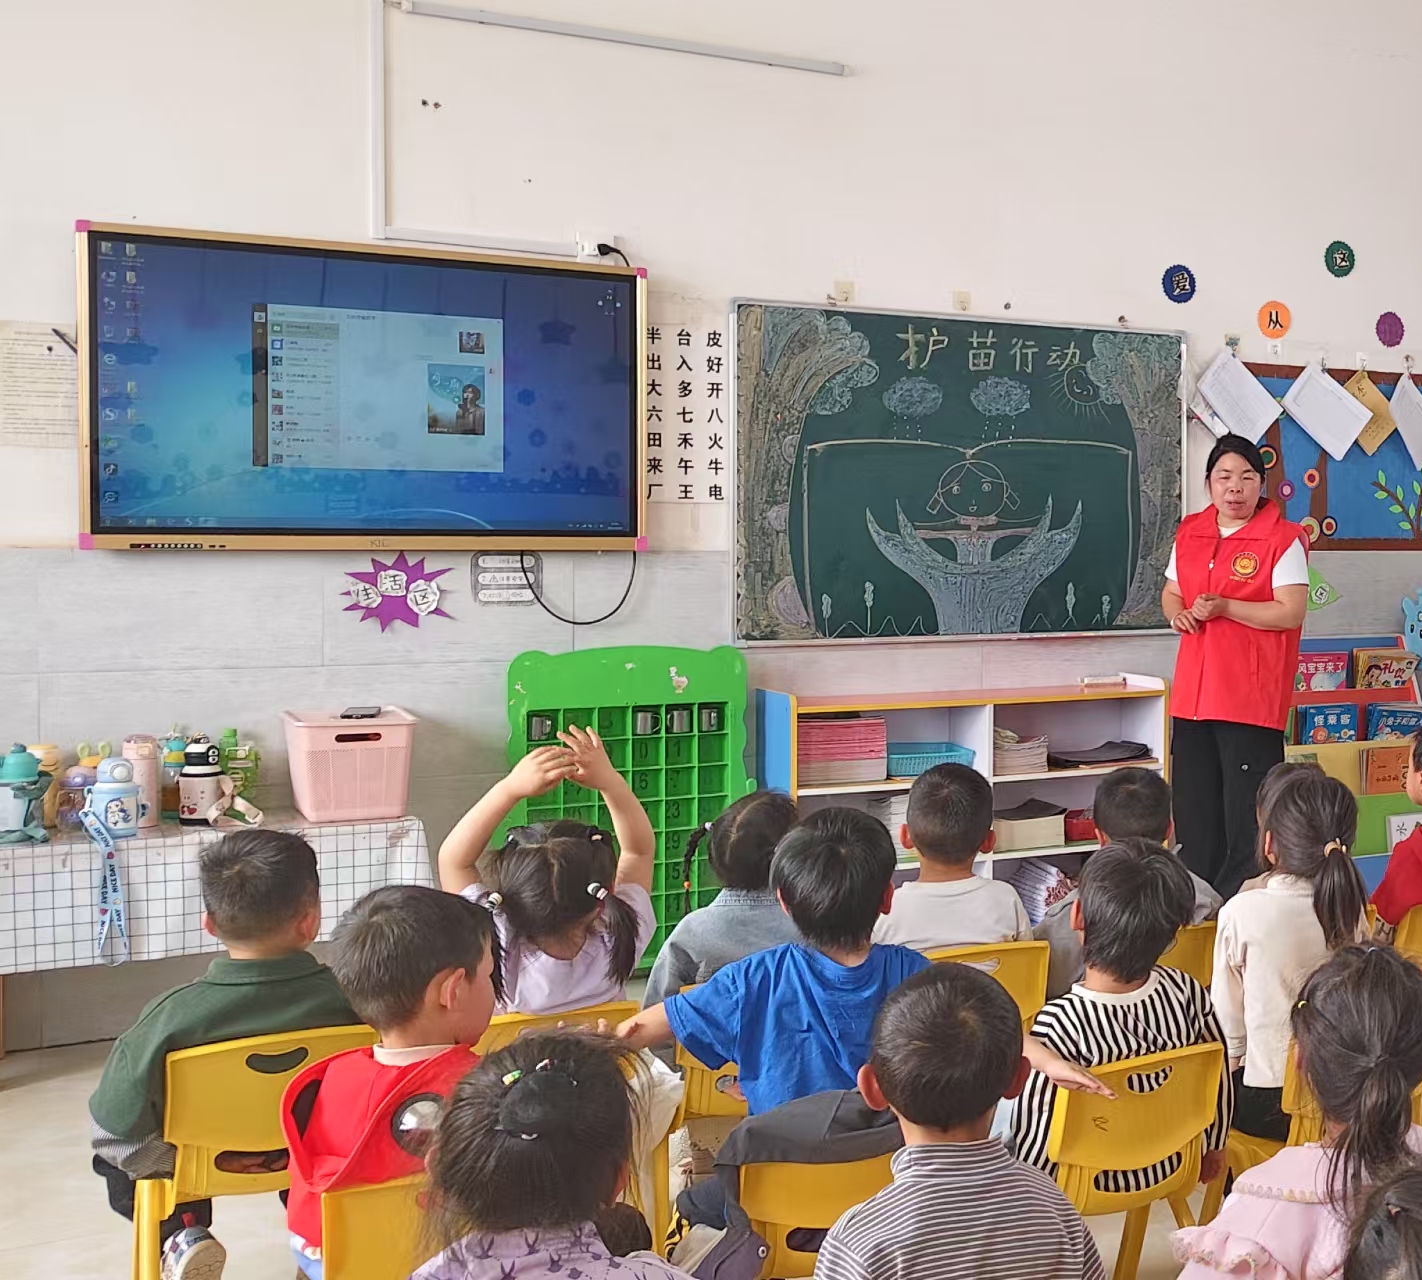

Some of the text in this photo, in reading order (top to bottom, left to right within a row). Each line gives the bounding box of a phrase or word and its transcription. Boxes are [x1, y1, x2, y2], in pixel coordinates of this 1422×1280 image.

[1333, 250, 1349, 268] 这
[1171, 273, 1190, 295] 爱
[1267, 310, 1283, 330] 从
[896, 323, 1080, 373] 护苗行动
[109, 878, 119, 893] NICE
